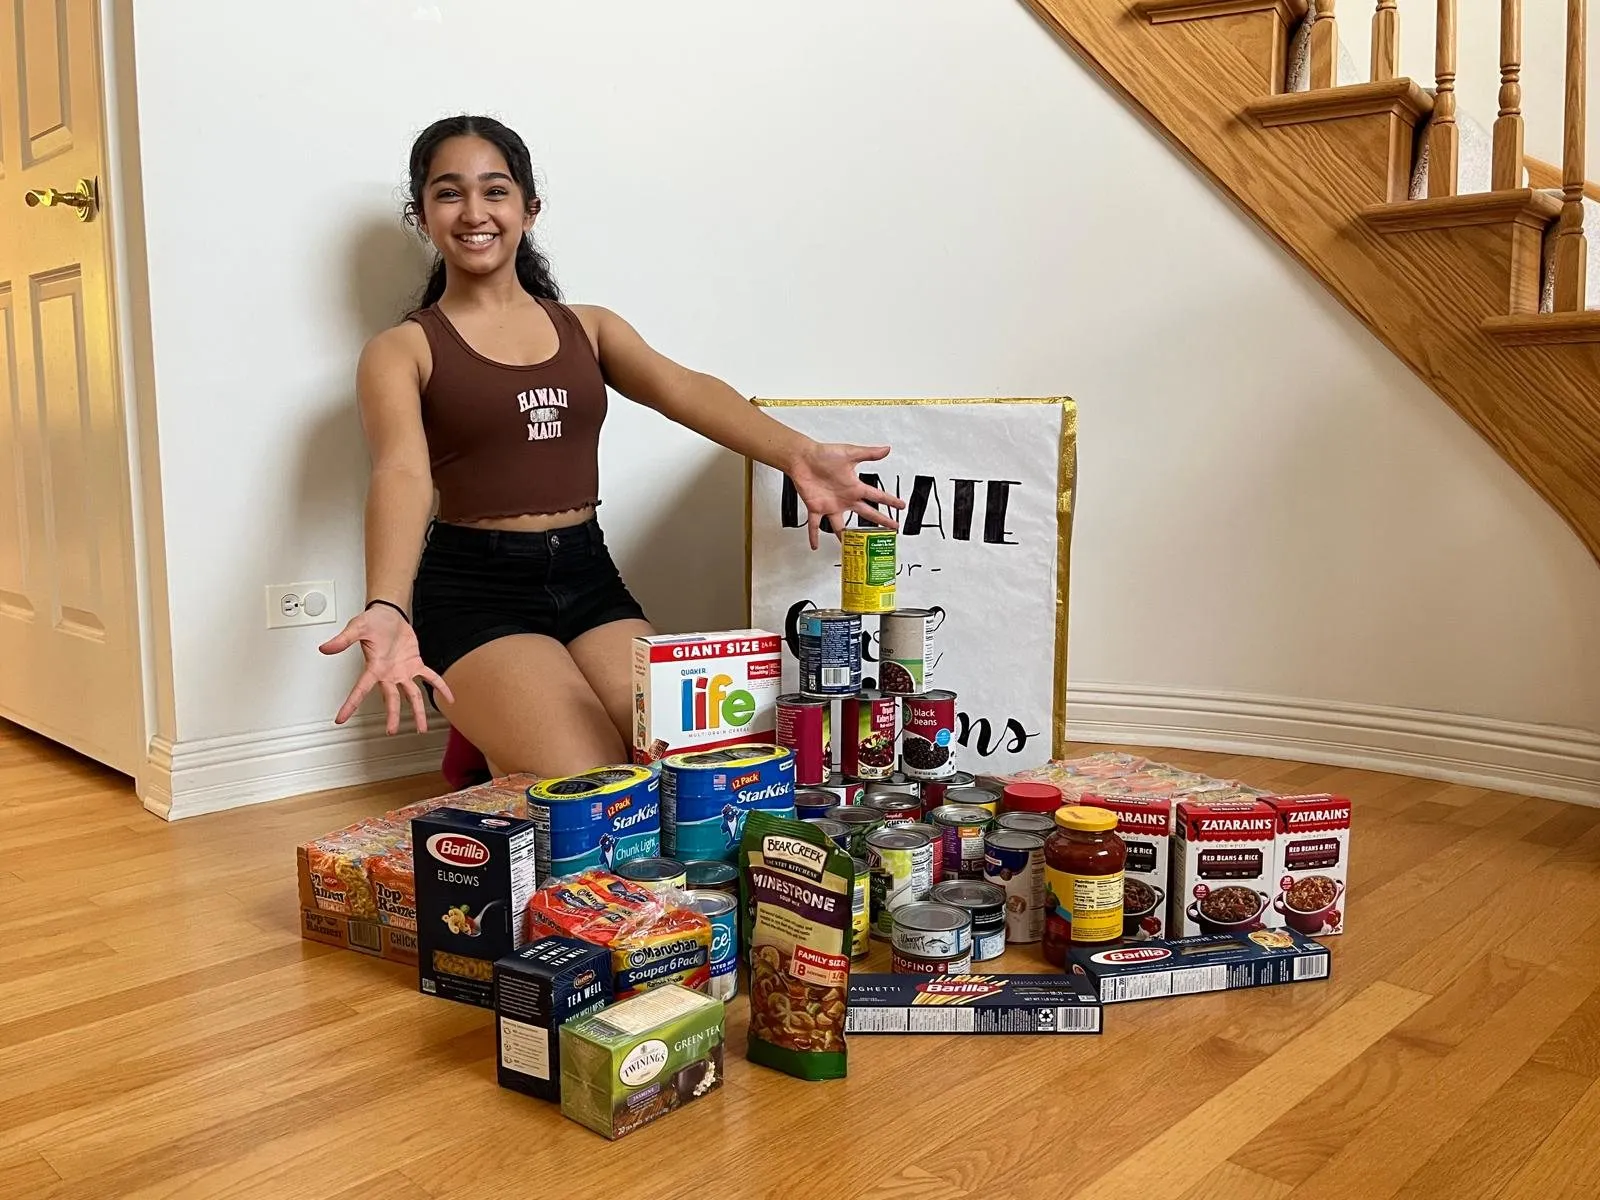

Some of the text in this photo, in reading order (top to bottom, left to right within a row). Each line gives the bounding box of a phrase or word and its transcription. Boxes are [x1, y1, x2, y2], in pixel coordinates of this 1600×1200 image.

[517, 388, 568, 412] HAWAII
[527, 421, 562, 440] MAUI
[781, 473, 1022, 545] DNATE
[673, 643, 722, 658] GIANT
[727, 641, 760, 654] SIZE
[681, 667, 706, 675] QUAKER
[681, 674, 756, 731] life
[914, 708, 935, 717] black
[732, 780, 741, 790] 12
[741, 774, 758, 785] Pack
[736, 782, 790, 804] StarKist
[607, 806, 616, 817] 12
[615, 797, 632, 811] Pack
[1289, 808, 1349, 823] ZATARAIN'S
[612, 803, 658, 832] StarKist
[1115, 811, 1167, 826] ARAIN'S
[1201, 819, 1272, 831] ZATARAIN'S
[441, 840, 485, 860] Barilla
[616, 843, 640, 860] Chunk
[767, 839, 824, 864] BEAR CREEK
[1244, 853, 1259, 861] RICE
[438, 870, 480, 887] ELBOWS
[314, 887, 345, 904] amen
[375, 881, 402, 903] Top
[753, 872, 836, 913] MINESTRONE
[377, 896, 416, 918] Rame
[390, 931, 417, 948] CHICK
[643, 939, 698, 959] Maruchan
[798, 949, 847, 968] FAMILY SIZE
[1110, 949, 1164, 961] Barilla
[628, 954, 699, 983] Souper 6 Pack
[797, 964, 806, 976] 8
[567, 981, 602, 1008] TEA WELL
[926, 984, 989, 992] Barilla
[674, 1025, 721, 1052] GREEN TEA
[623, 1052, 667, 1078] TWININGS
[617, 1126, 626, 1136] 20
